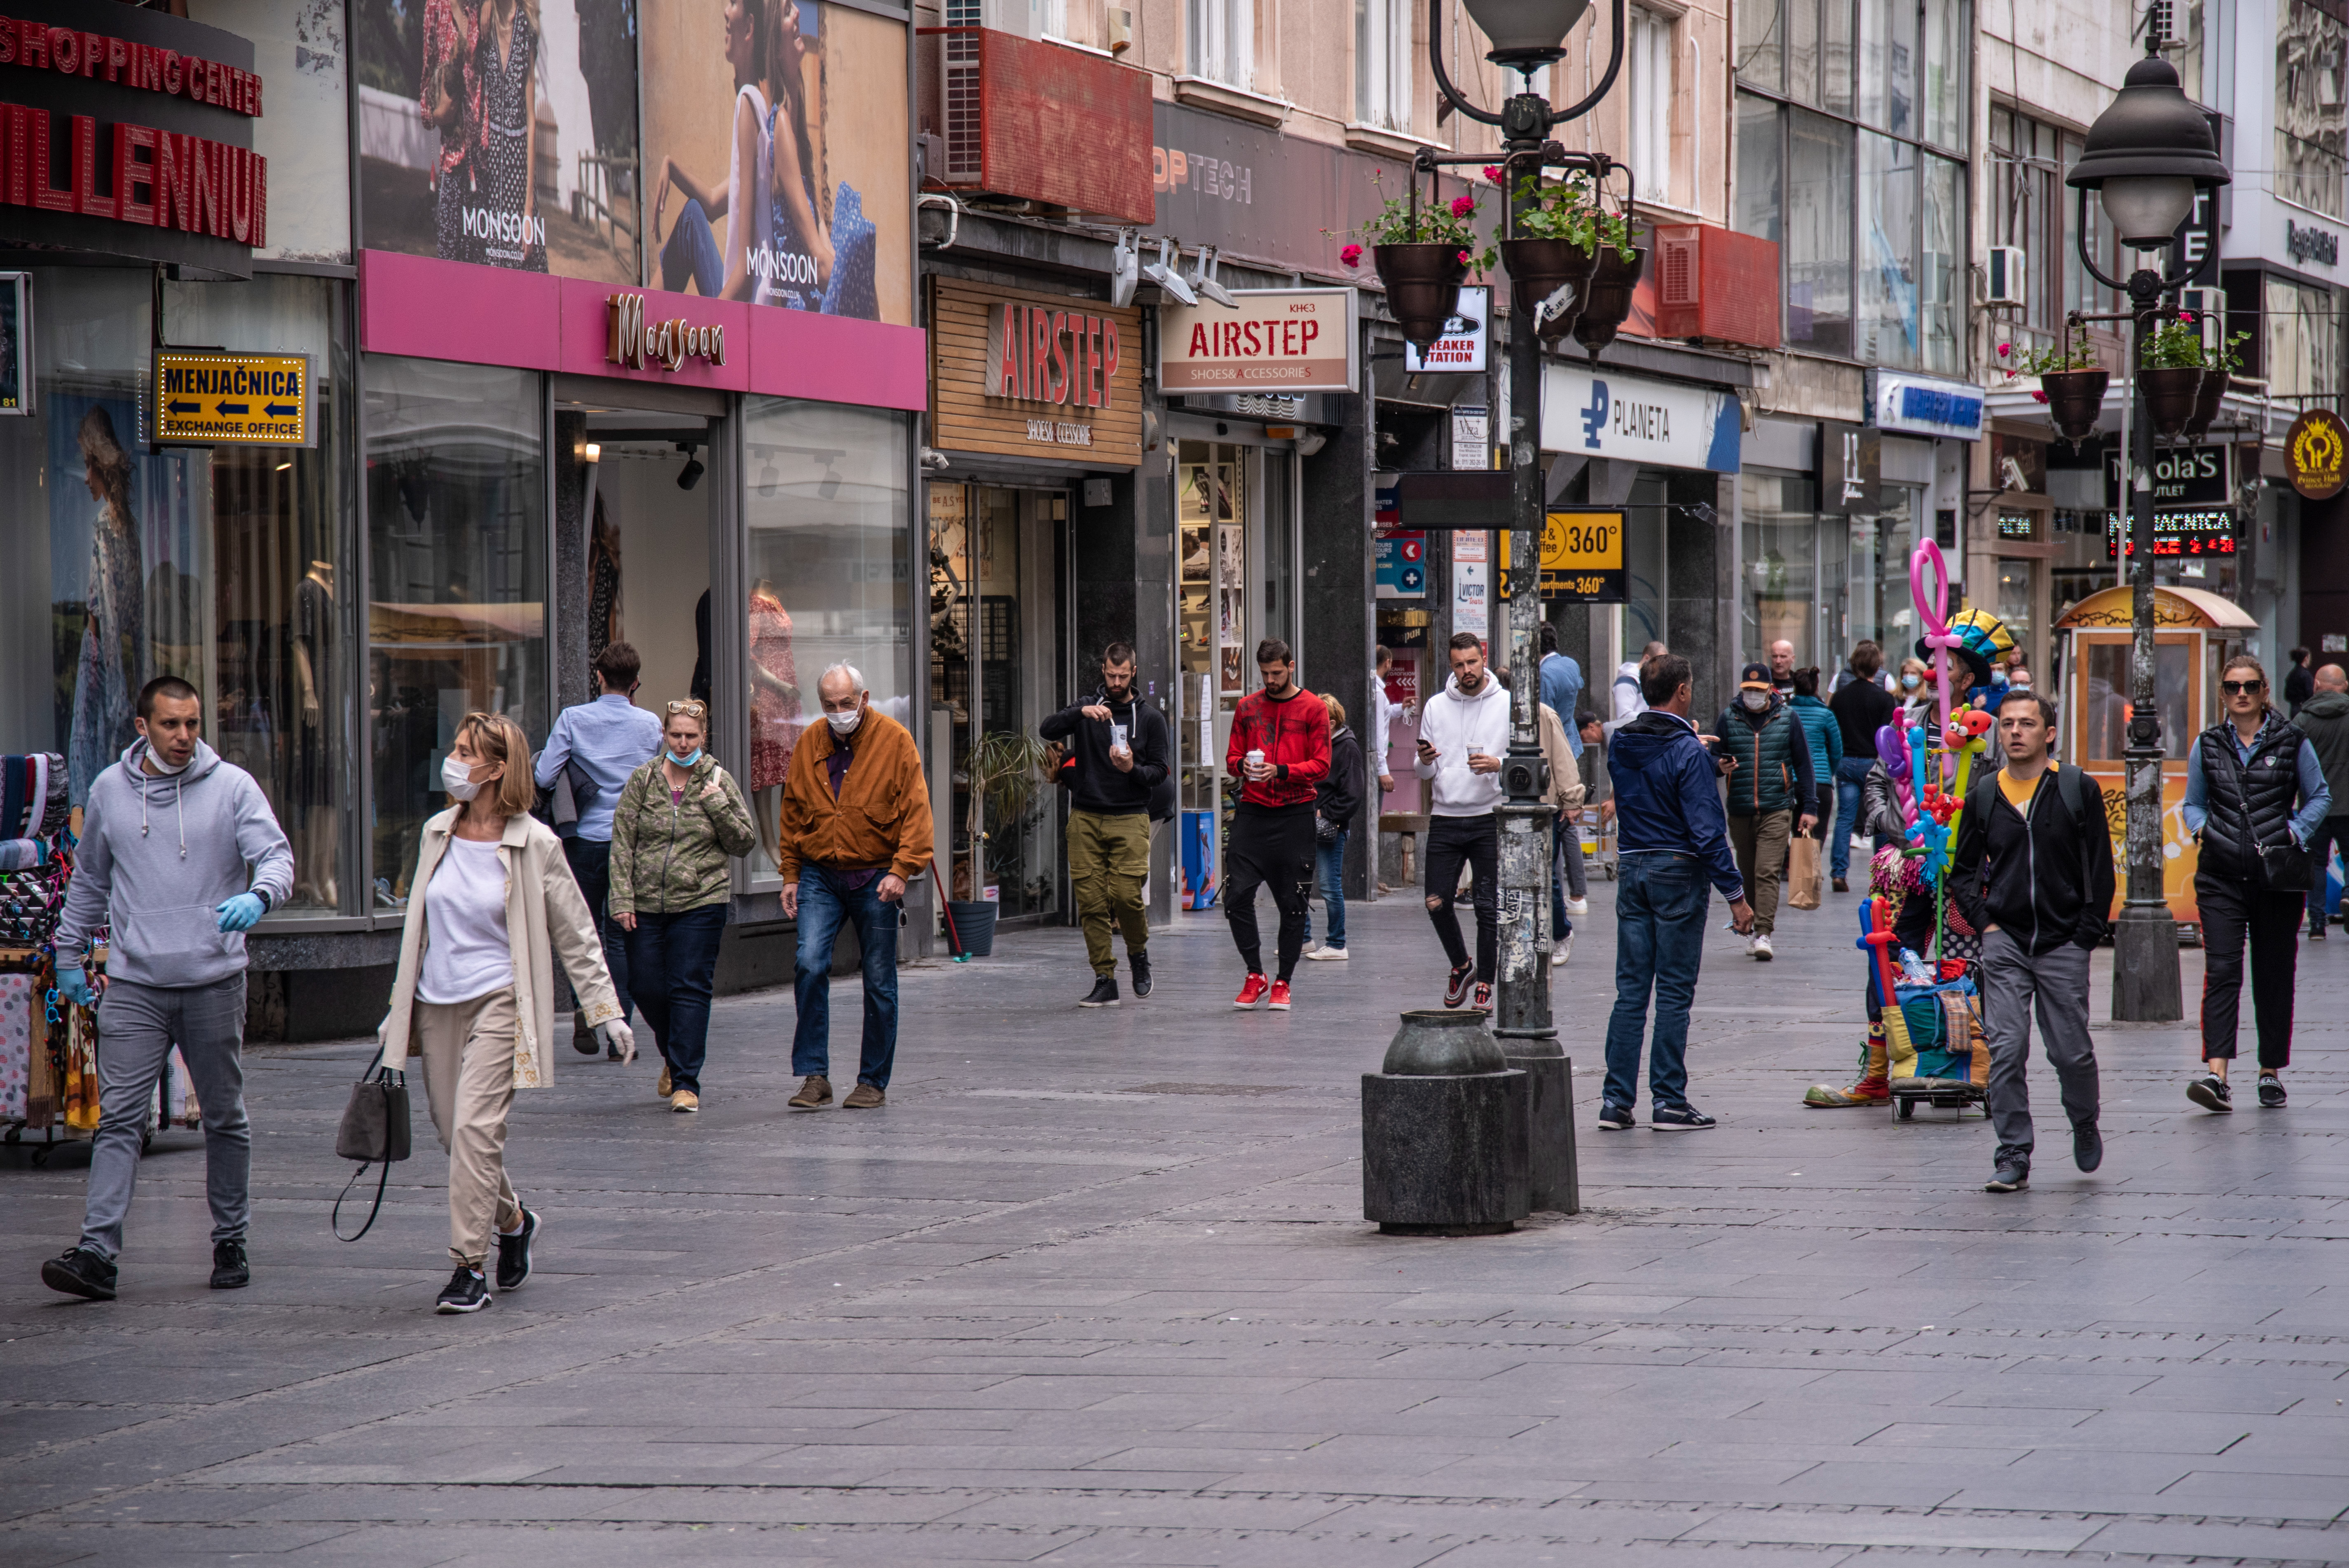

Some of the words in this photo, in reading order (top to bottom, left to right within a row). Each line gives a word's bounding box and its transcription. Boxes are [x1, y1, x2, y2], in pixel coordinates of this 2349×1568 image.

[189, 56, 264, 117] CENTER
[0, 101, 267, 249] ILLENNIUM
[463, 206, 545, 246] MONSOON
[747, 246, 818, 285] MONSOON
[766, 288, 801, 299] MONSOON.CO.UK
[615, 293, 726, 372] Monsoon
[1189, 319, 1319, 358] AIRSTEP
[1000, 303, 1119, 409] AIRSTEP
[1191, 367, 1312, 380] SHOES&ACCESSORIES
[165, 365, 299, 397] MENJAČNICA
[166, 420, 243, 433] EXCHANGE
[248, 422, 298, 435] OFFICE
[1026, 419, 1094, 447] SHOES&ACCESSORIES
[1614, 400, 1670, 443] PLANETA
[1462, 584, 1485, 597] VICTOR
[1468, 597, 1484, 605] tours
[1540, 579, 1575, 590] partments
